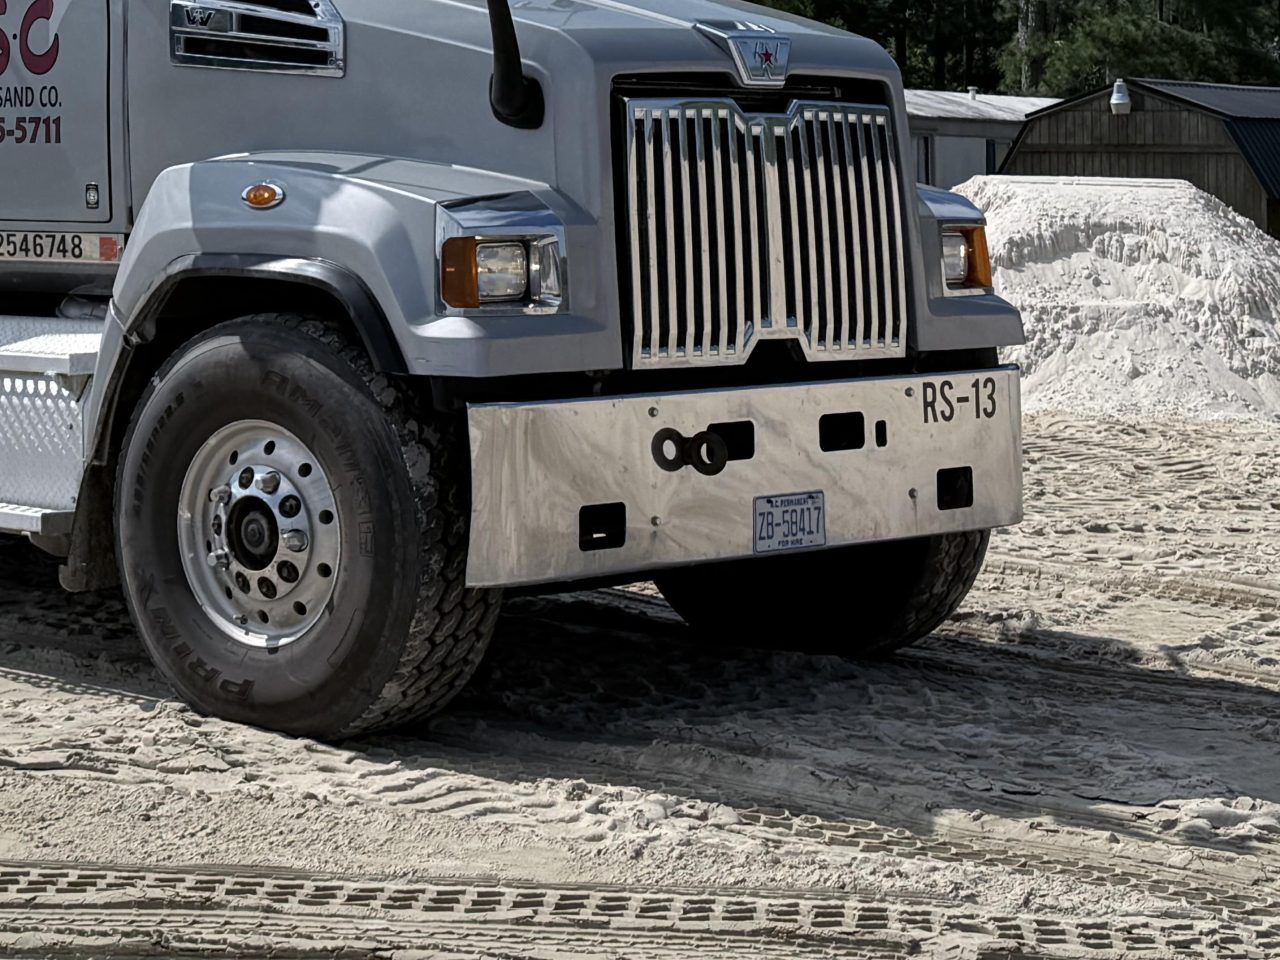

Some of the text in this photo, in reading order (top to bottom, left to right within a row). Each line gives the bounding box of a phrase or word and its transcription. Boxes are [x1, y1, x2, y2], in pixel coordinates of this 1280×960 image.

[39, 85, 62, 108] CO.
[922, 376, 997, 424] RS-13
[758, 506, 822, 541] ZB-58417
